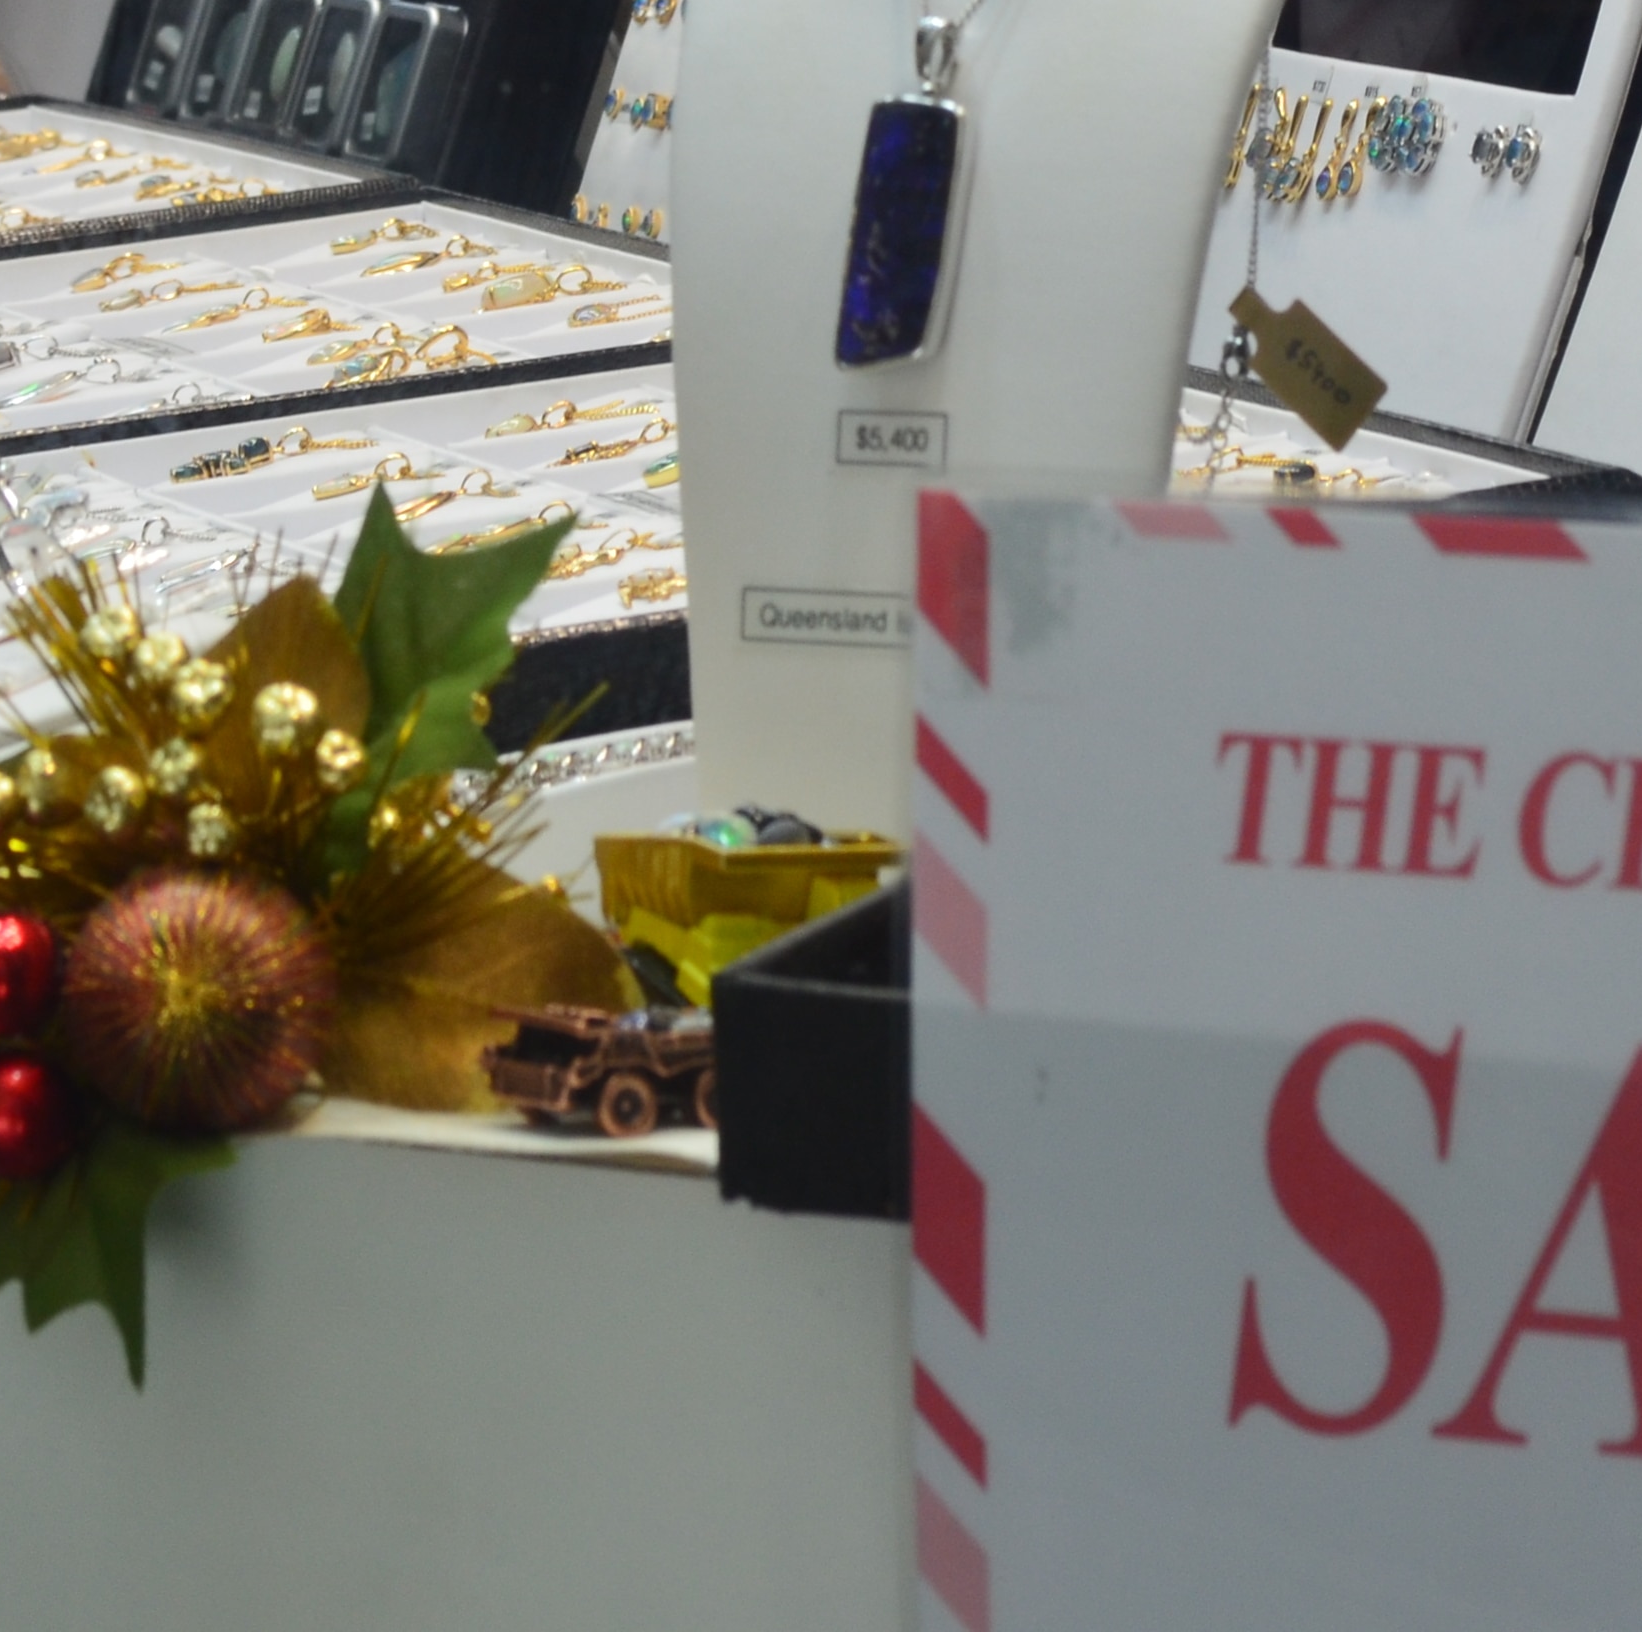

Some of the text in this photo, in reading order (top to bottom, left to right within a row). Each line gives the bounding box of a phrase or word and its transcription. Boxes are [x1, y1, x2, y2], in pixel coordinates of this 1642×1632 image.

[856, 424, 929, 453] $5,400
[759, 602, 888, 634] Queensland
[1219, 732, 1486, 880] THE
